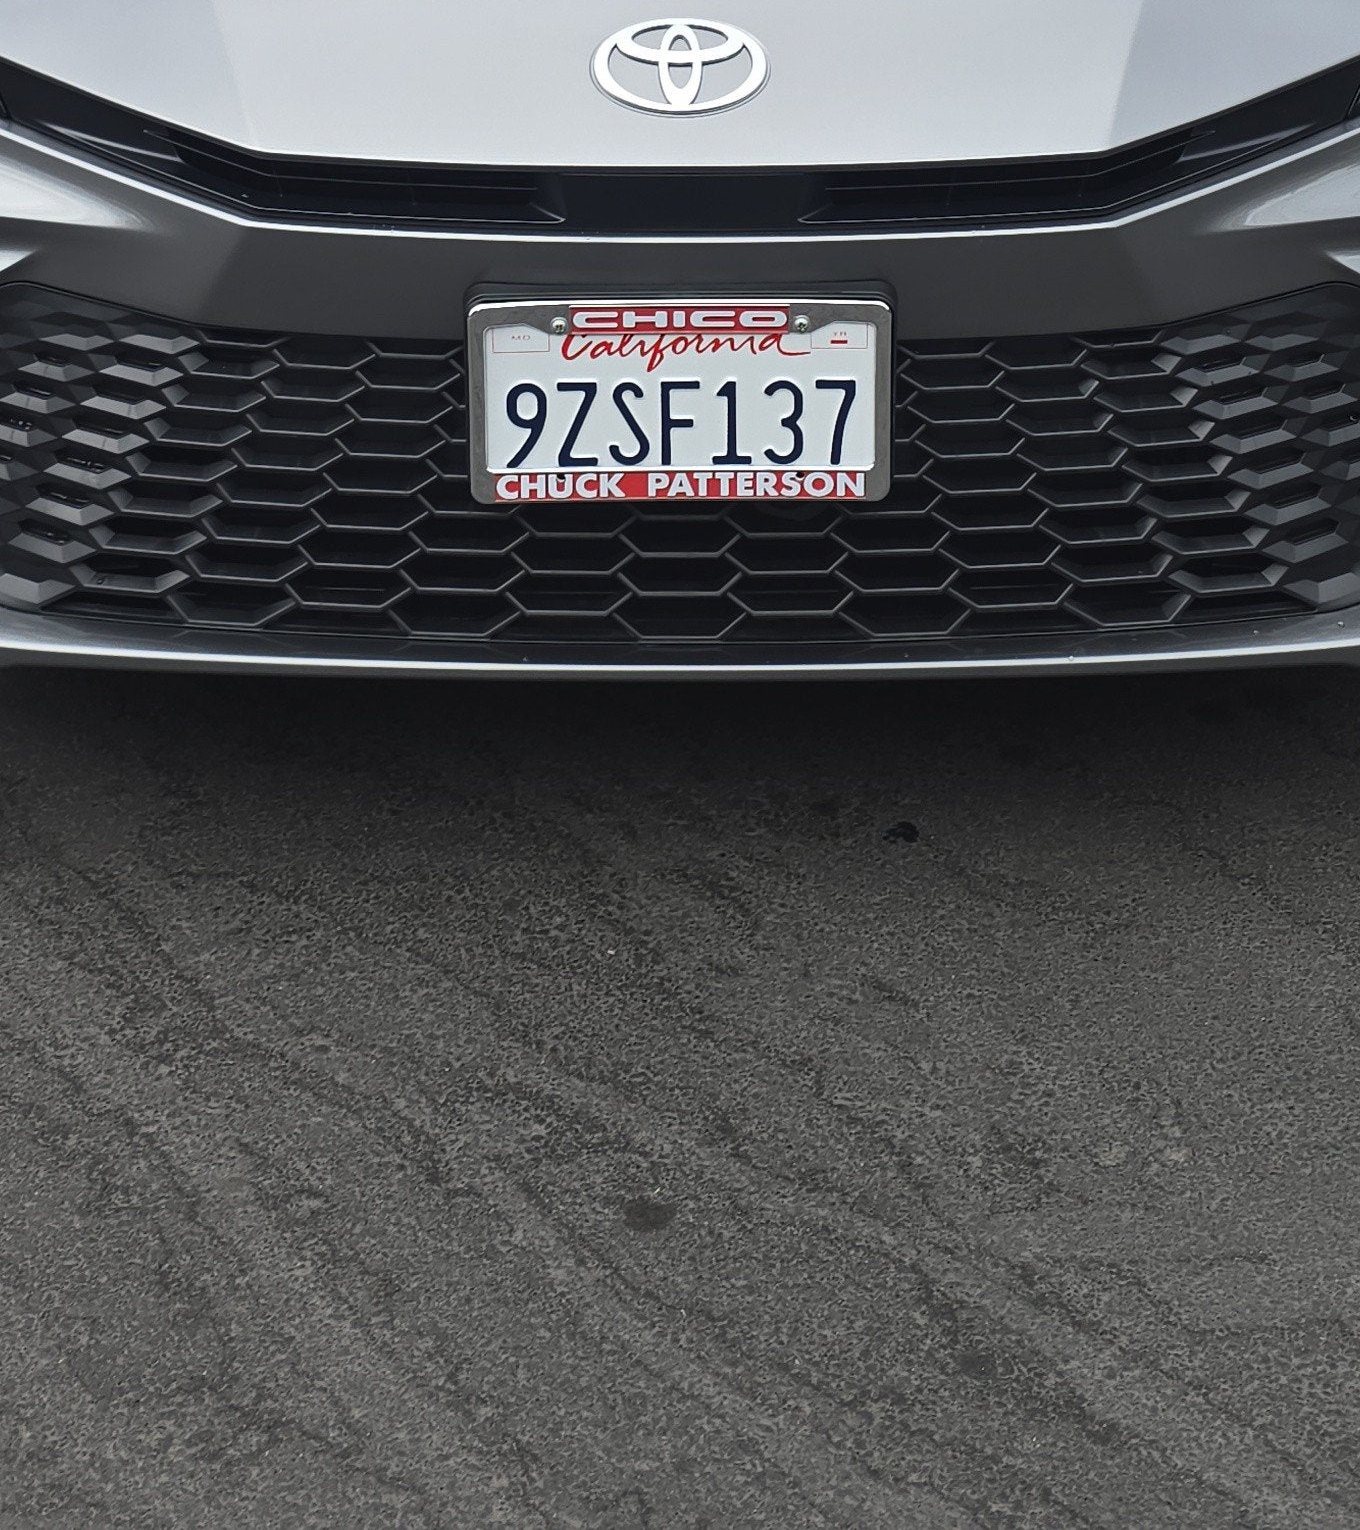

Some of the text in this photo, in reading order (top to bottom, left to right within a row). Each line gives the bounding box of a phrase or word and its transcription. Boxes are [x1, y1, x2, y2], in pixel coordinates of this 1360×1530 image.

[572, 310, 788, 329] CHICO
[561, 333, 811, 372] California
[506, 379, 857, 469] 9ZSF137
[495, 471, 866, 500] CHUCK PATTERSON
